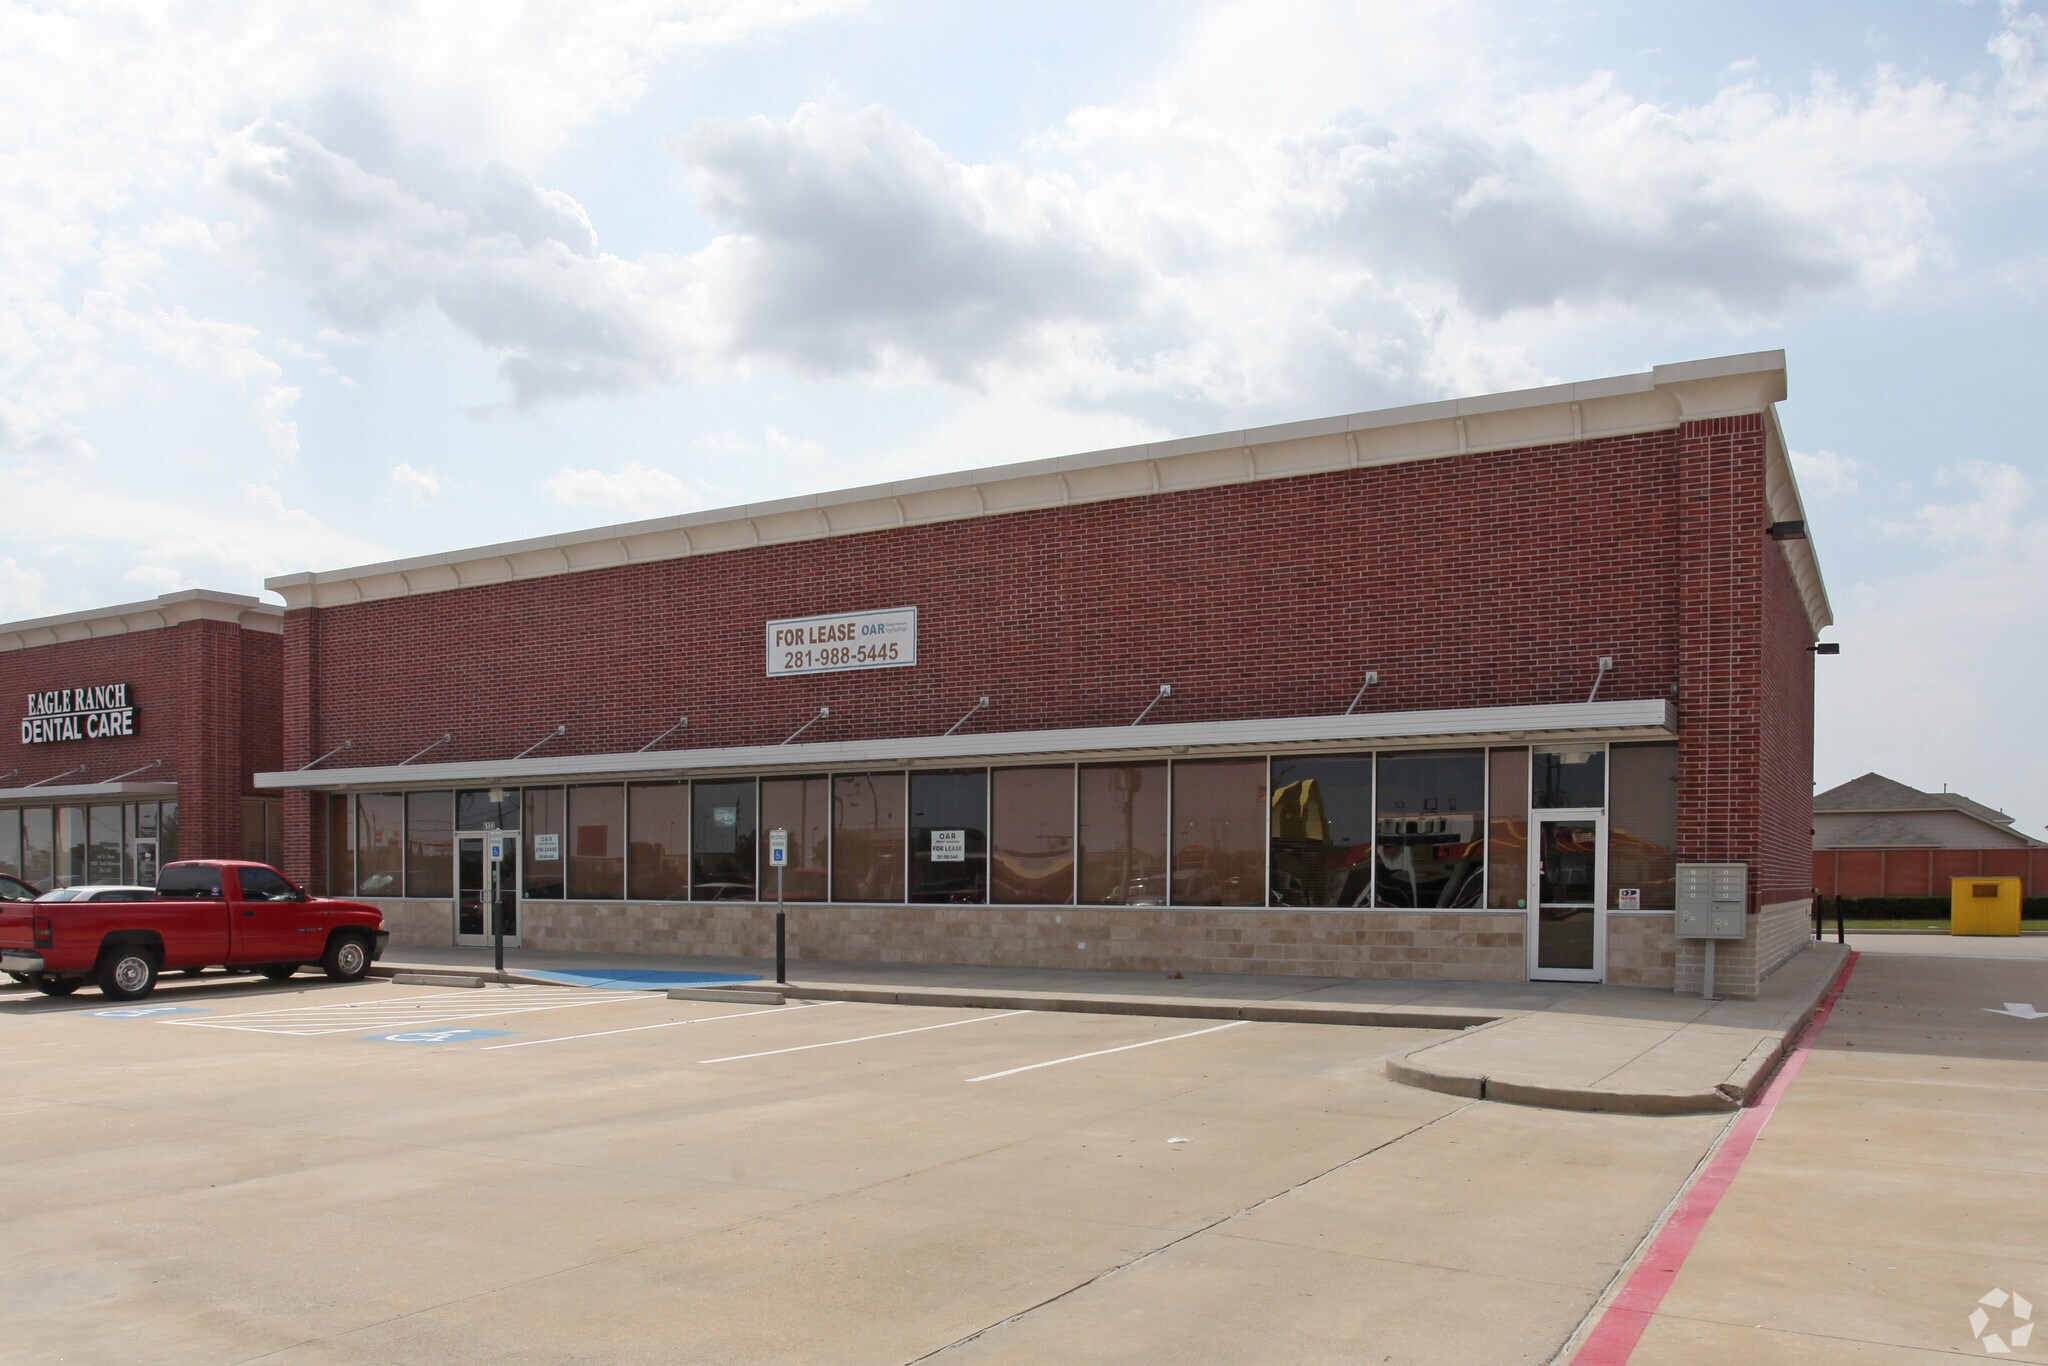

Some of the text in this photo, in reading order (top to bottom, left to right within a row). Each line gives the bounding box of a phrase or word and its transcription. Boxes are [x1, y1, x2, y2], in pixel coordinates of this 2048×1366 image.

[776, 623, 885, 647] FOR LEASE OAR
[784, 642, 899, 669] 281-988-5445
[27, 683, 126, 716] EAGLE RANCH
[22, 711, 133, 744] DENTAL CARE
[939, 832, 956, 840] OAR
